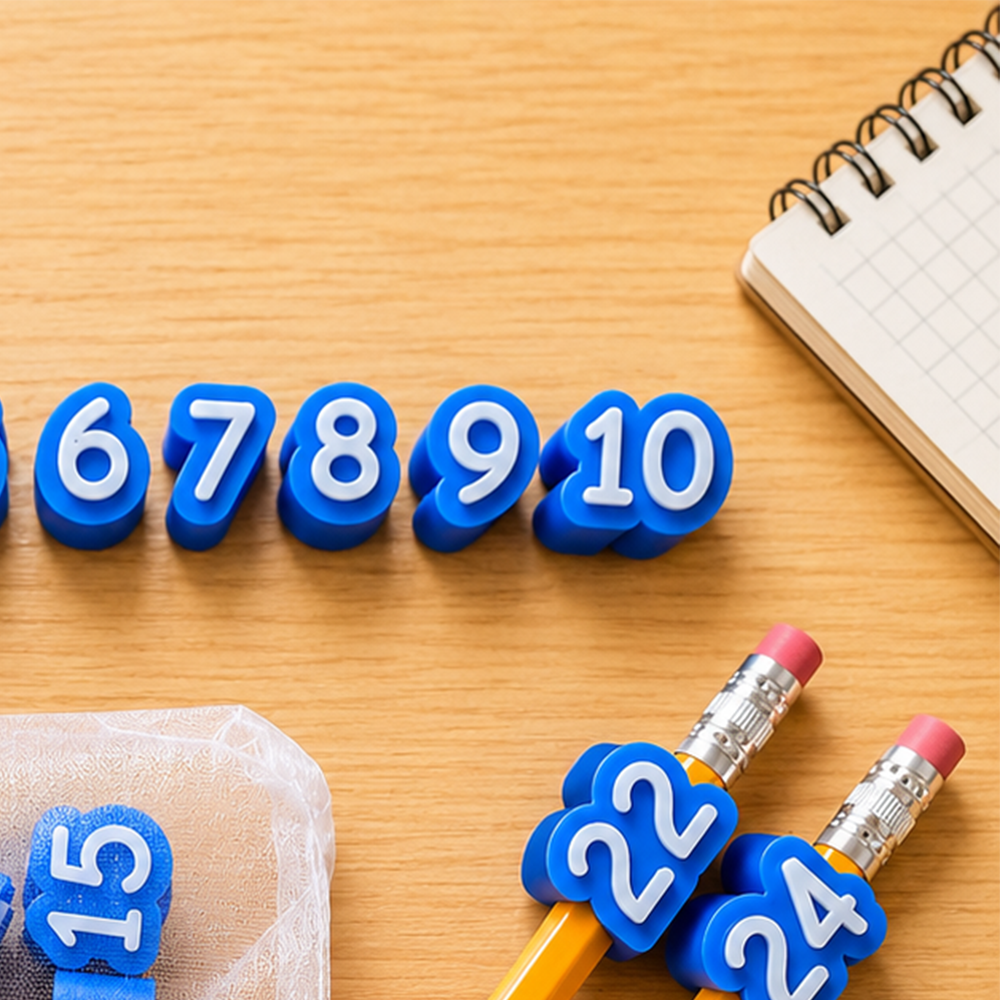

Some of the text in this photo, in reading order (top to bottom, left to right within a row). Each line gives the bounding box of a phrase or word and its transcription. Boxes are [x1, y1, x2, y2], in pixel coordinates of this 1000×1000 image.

[58, 398, 128, 499] 6
[189, 400, 254, 500] 7
[312, 399, 379, 500] 8
[450, 402, 518, 502] 9
[582, 408, 714, 509] 10
[47, 824, 152, 952] 15
[567, 761, 718, 924] 22
